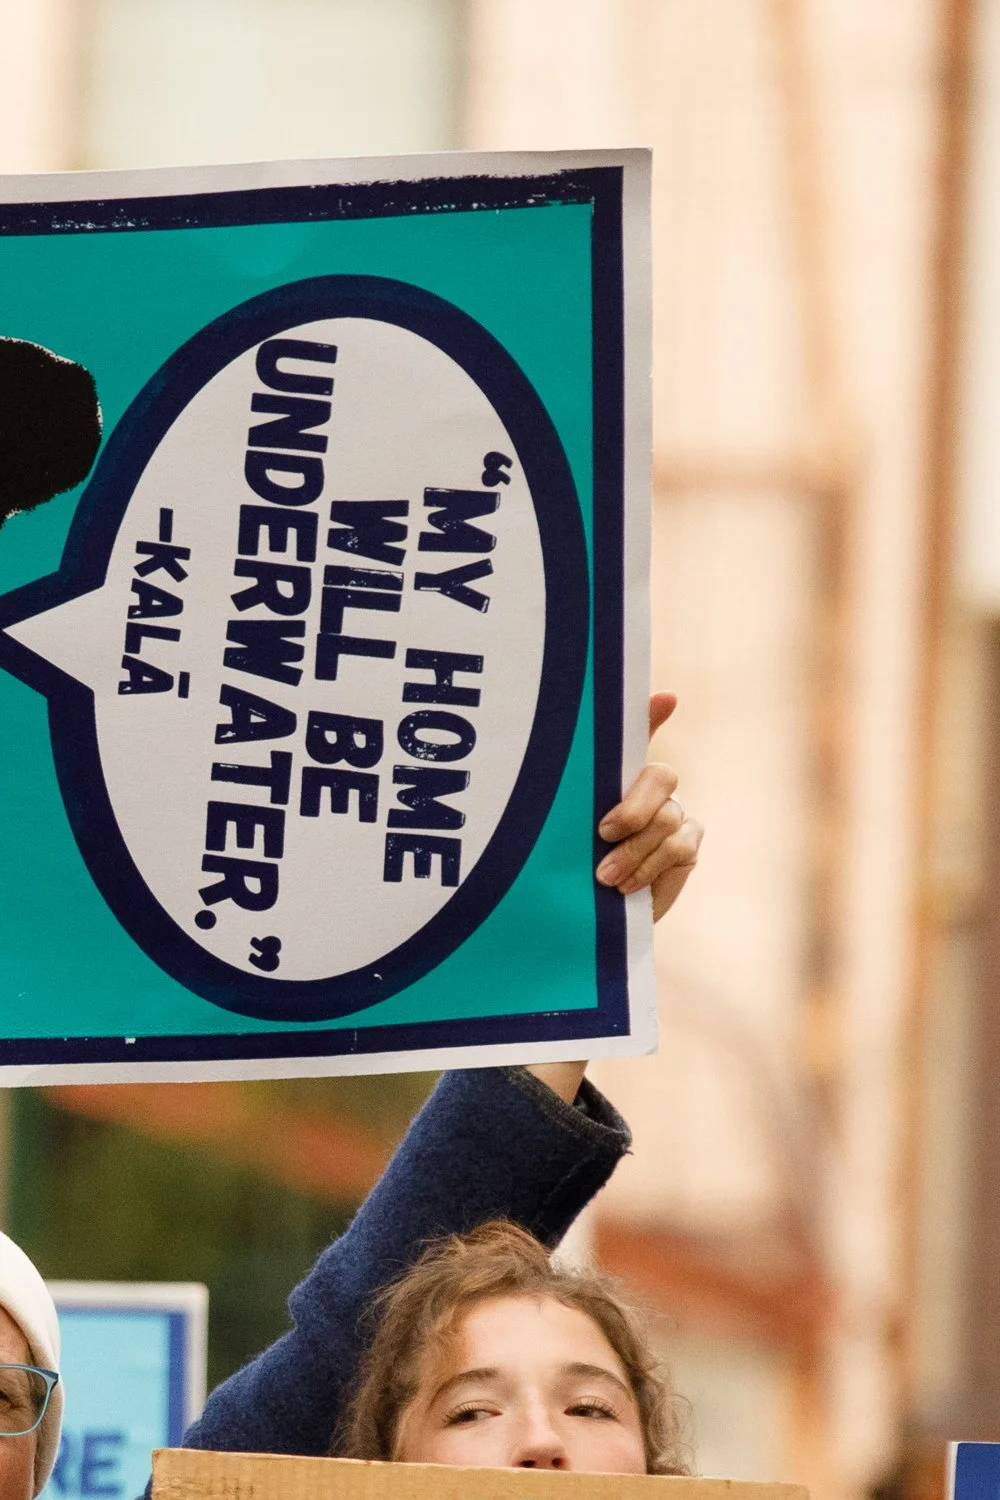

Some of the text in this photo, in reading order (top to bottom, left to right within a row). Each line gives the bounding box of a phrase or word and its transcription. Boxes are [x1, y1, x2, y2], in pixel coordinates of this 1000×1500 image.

[193, 337, 339, 972] UNDERWATER.”
[298, 499, 410, 824] WILL BE
[382, 451, 513, 888] “MY HOME
